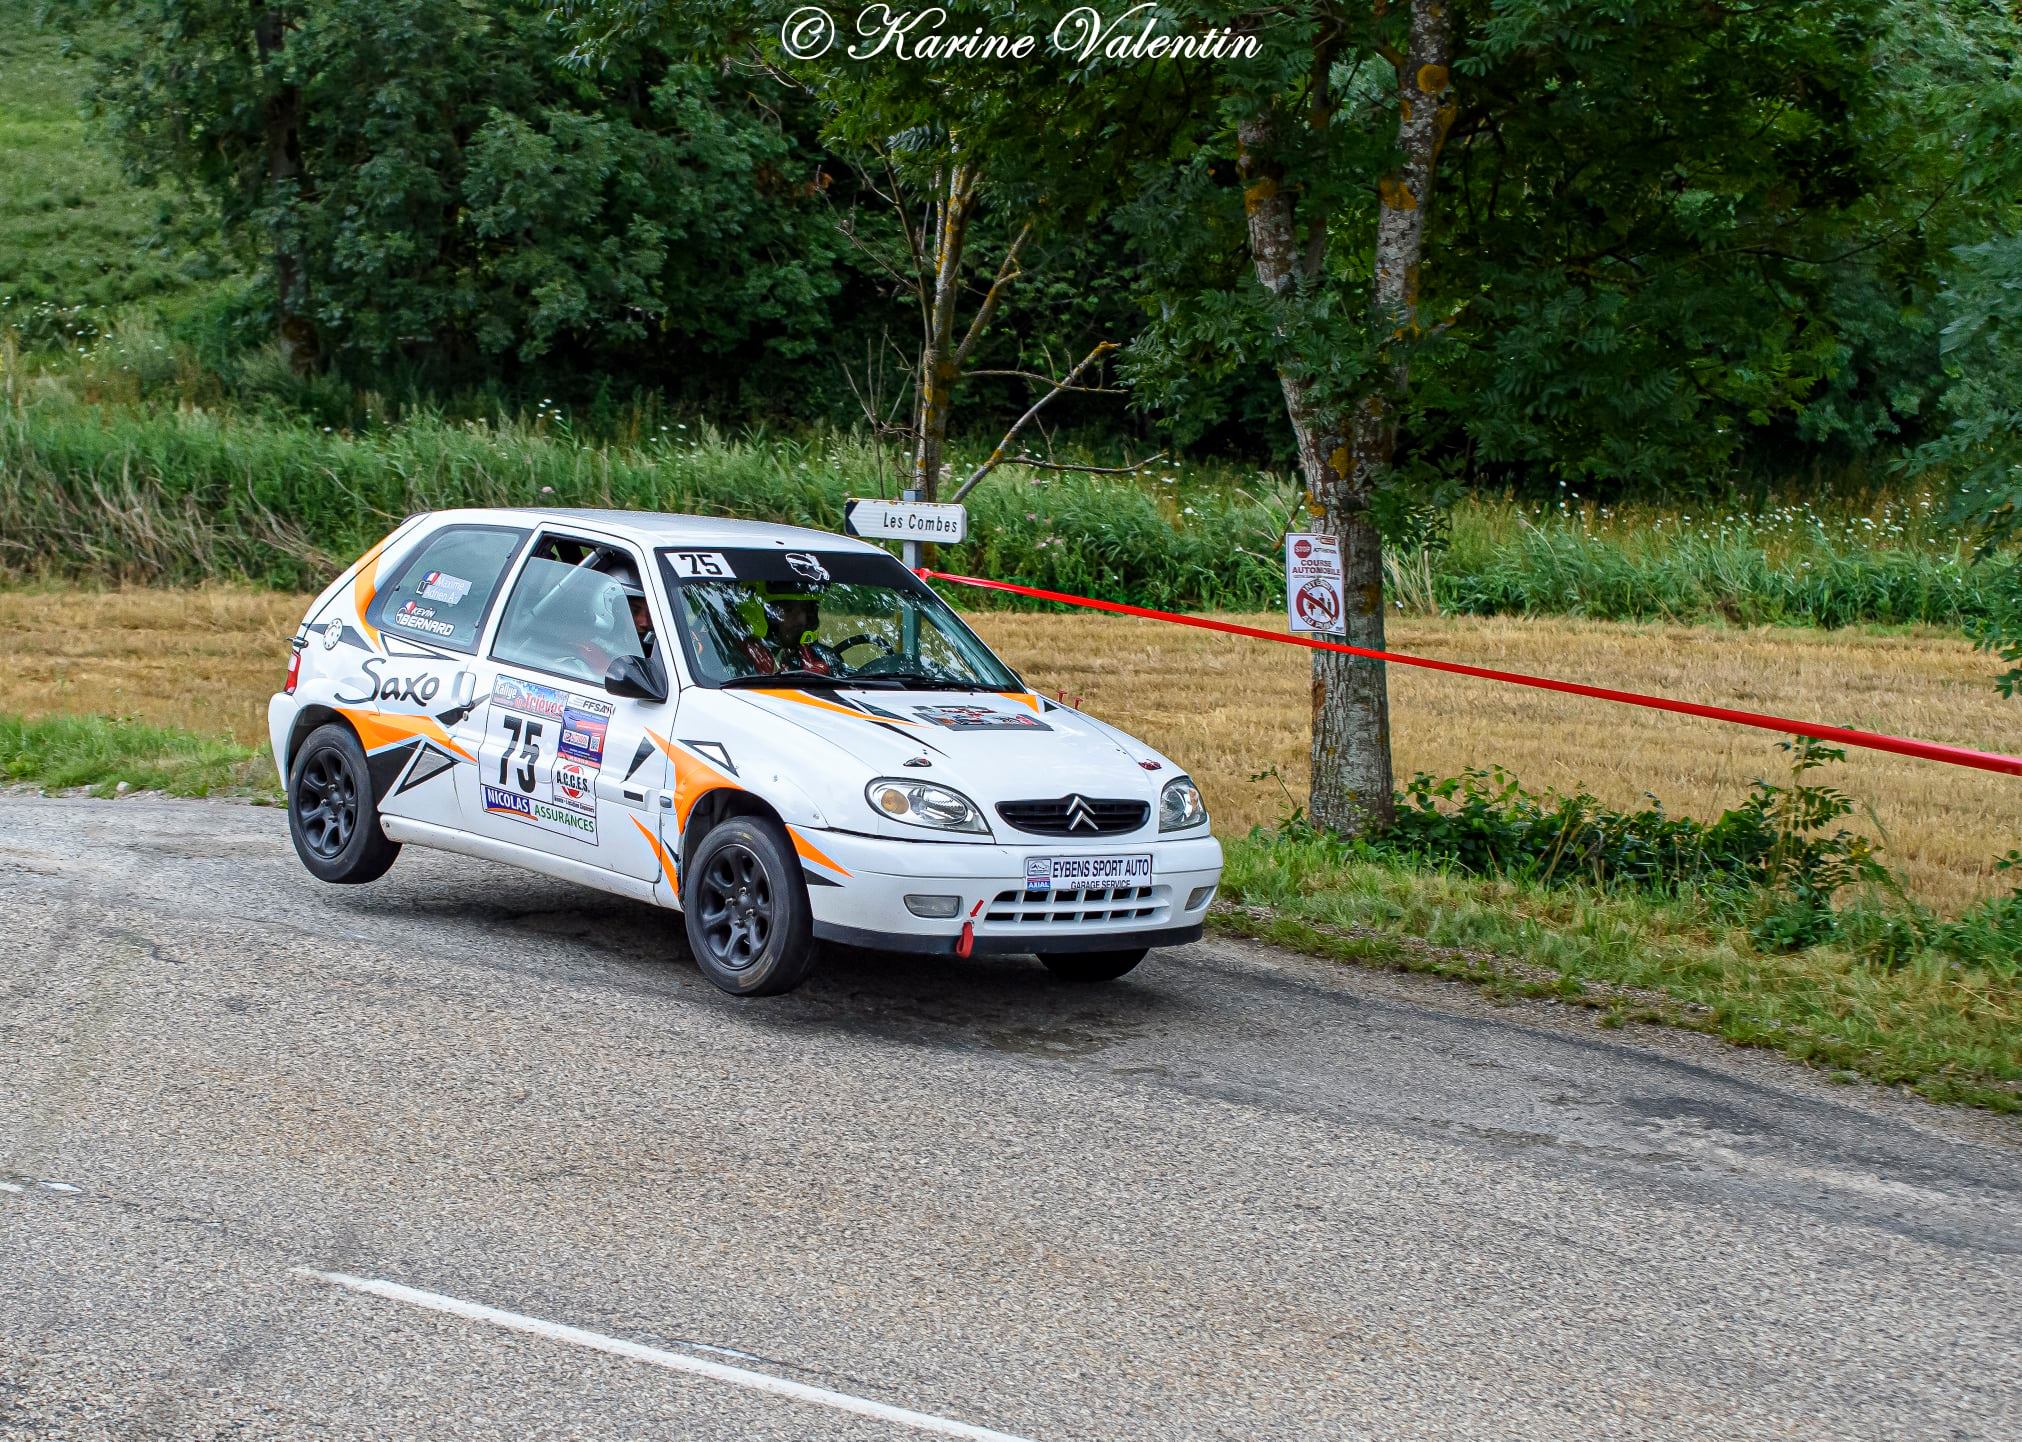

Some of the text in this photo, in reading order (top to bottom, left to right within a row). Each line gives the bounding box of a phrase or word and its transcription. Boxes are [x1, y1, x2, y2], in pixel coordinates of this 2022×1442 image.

[883, 512, 957, 533] Les Combes
[1295, 545, 1312, 554] STOP
[679, 554, 723, 575] 75
[1292, 566, 1341, 576] AUTOMOBILE
[1300, 559, 1332, 568] COURSE
[401, 613, 455, 637] BERNARD
[334, 657, 440, 707] Saxo
[499, 714, 543, 794] 75
[487, 788, 530, 813] NICOLAS
[534, 804, 595, 833] ASSURANCES
[1052, 859, 1149, 878] EYBENS SPORT AUTO
[1028, 881, 1050, 889] AXIAL
[1070, 879, 1131, 890] GARAGE SERVICE
